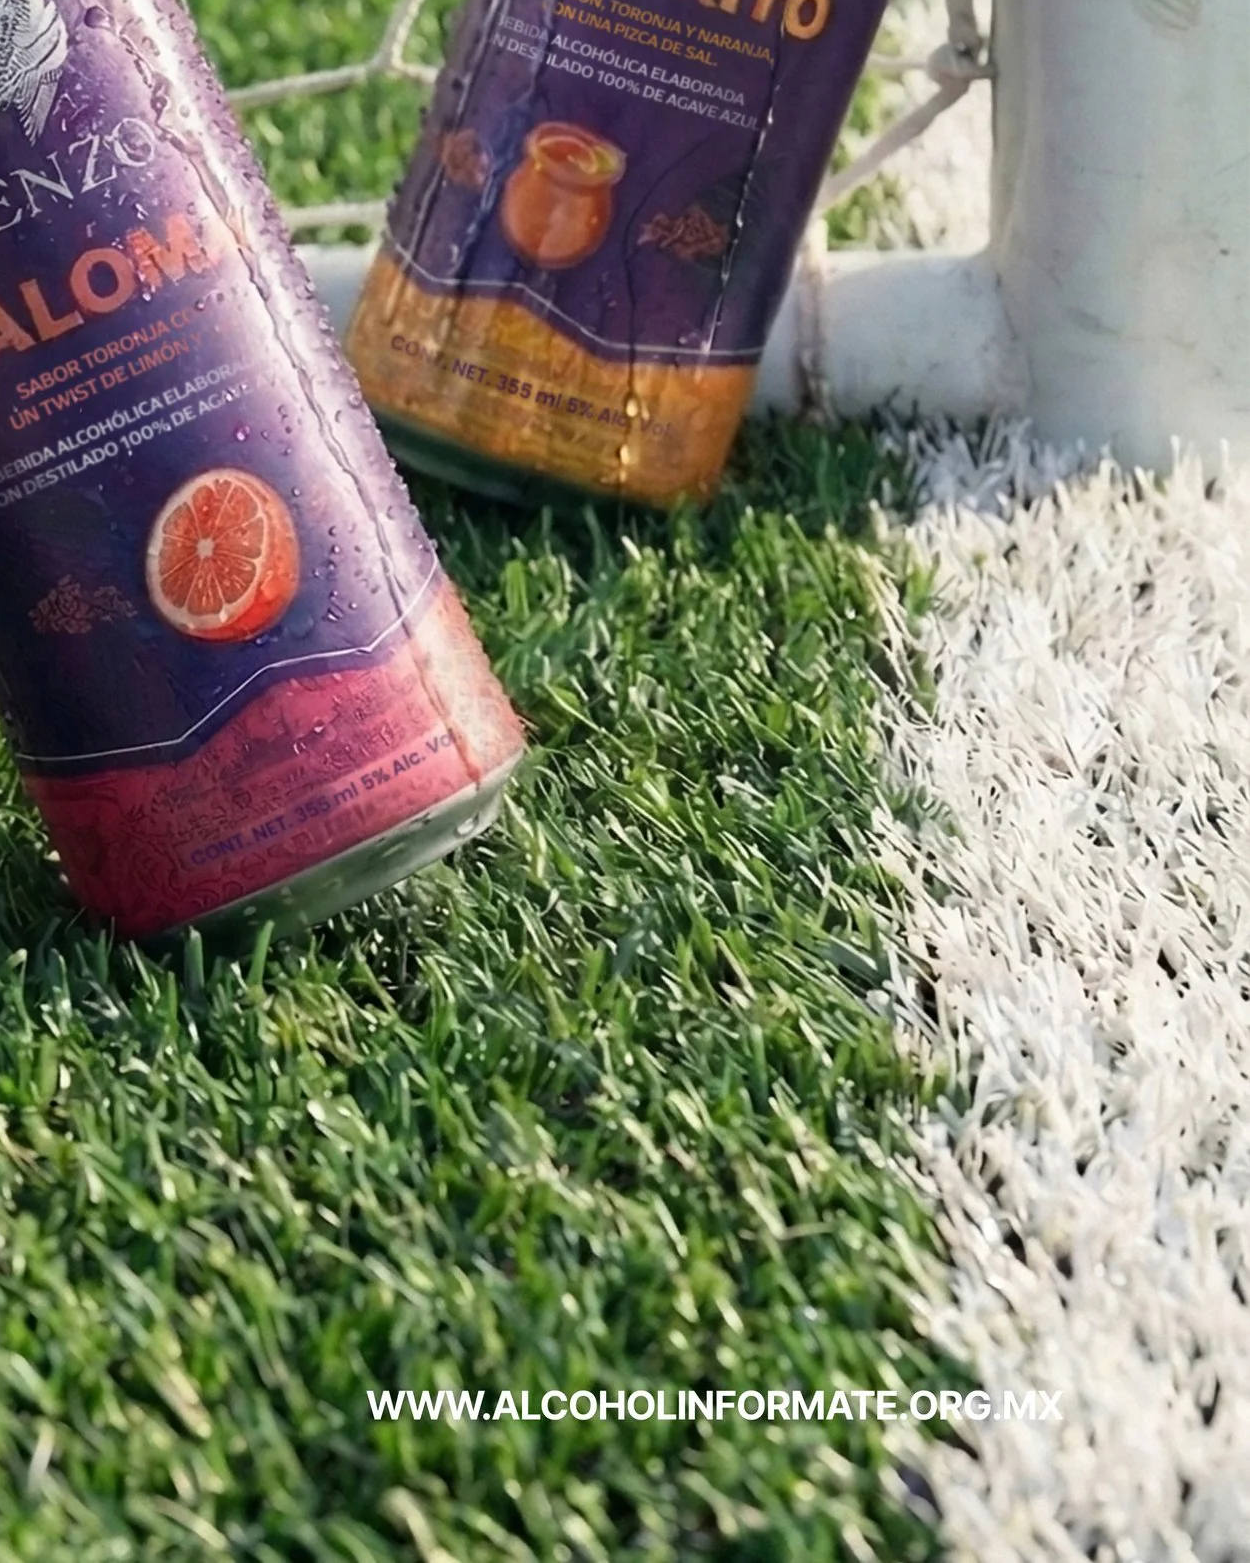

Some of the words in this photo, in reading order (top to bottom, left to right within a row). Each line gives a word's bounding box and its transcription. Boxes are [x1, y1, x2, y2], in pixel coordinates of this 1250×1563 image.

[550, 34, 648, 76] ALCOHÓLICA
[650, 66, 745, 107] ELABORADA
[578, 10, 611, 32] UNA
[613, 23, 658, 49] PIZCA
[661, 38, 684, 56] DE
[685, 45, 718, 67] SAL.
[610, 0, 682, 35] TORONJA
[686, 24, 698, 38] Y
[697, 28, 775, 66] NARANJA,
[507, 38, 594, 79] DESILADO
[596, 70, 640, 95] 100%
[642, 85, 666, 103] DE
[666, 94, 718, 119] AGAVE
[718, 109, 760, 132] AZUL
[9, 406, 41, 430] UN
[40, 379, 98, 416] TWIST
[99, 365, 129, 390] DE
[128, 338, 190, 378] LIMÓN
[16, 359, 83, 400] SABOR
[81, 320, 170, 370] TORONJA
[451, 358, 491, 386] NET.
[496, 373, 532, 400] 355
[534, 387, 561, 410] ml
[565, 395, 594, 420] 5%
[23, 442, 119, 496] DESTILADO
[120, 418, 172, 450] 100%
[170, 405, 198, 428] DE
[198, 380, 254, 416] AGAVE
[57, 397, 164, 456] ALCOHÓLICA
[190, 834, 250, 866] CONT.
[252, 816, 295, 843] NET.
[294, 795, 332, 824] 355
[333, 781, 360, 812] ml
[360, 765, 391, 791] 5%
[391, 751, 426, 780] Alc.
